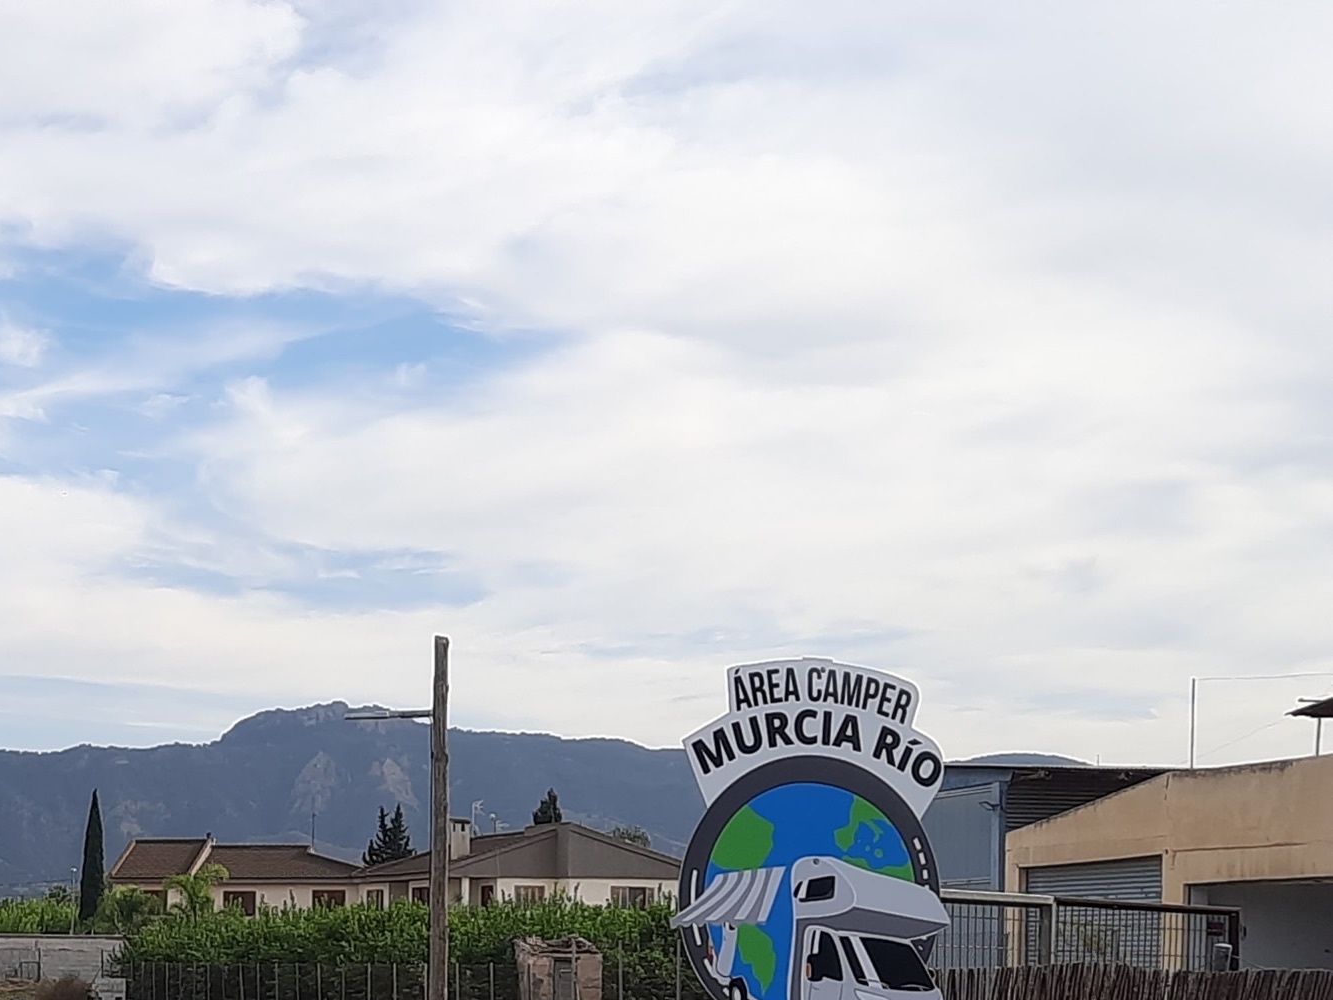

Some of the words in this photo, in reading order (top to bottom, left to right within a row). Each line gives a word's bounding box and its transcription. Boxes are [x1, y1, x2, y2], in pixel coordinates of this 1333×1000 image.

[733, 667, 801, 712] ÁREA
[807, 667, 912, 725] CAMPER
[691, 709, 862, 775] MURCIA
[872, 725, 942, 787] RÍO
